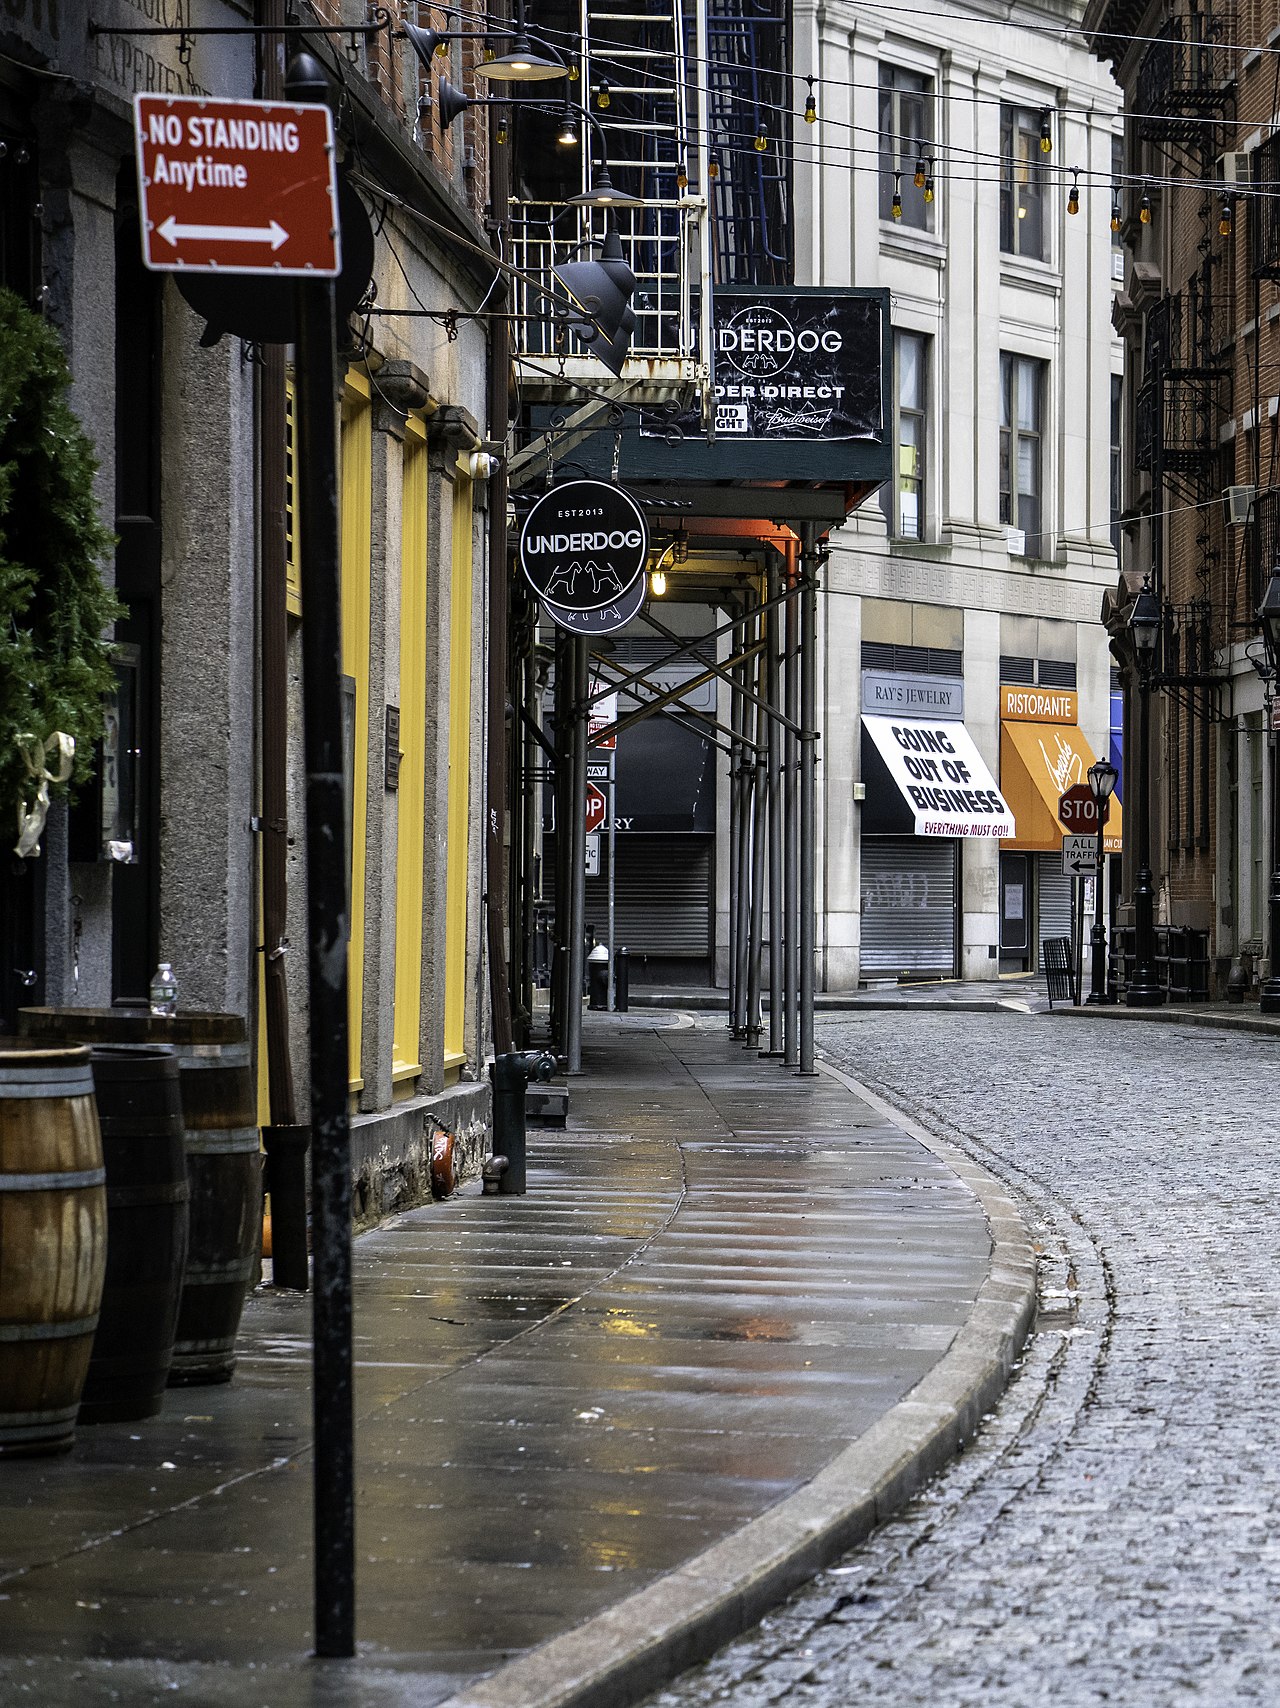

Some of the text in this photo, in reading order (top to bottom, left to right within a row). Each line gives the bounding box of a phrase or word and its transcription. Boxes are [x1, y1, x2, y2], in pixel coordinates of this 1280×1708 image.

[149, 114, 300, 153] NO STANDING
[153, 153, 248, 193] Anytime
[679, 329, 842, 353] UDERDOG
[764, 386, 845, 398] DIRECT
[715, 408, 738, 418] UD
[766, 412, 831, 425] Budweiser
[558, 508, 603, 518] EST2013
[527, 529, 642, 554] UNDERDOG
[875, 686, 952, 705] RAY'S JEWELRY
[1007, 693, 1072, 717] RISTORANTE
[891, 726, 956, 754] GOING
[903, 755, 972, 784] OUT OF
[907, 785, 1005, 814] BUSINESS
[924, 821, 1009, 837] EVERYTHING MUST GO!!
[1072, 838, 1095, 849] ALL
